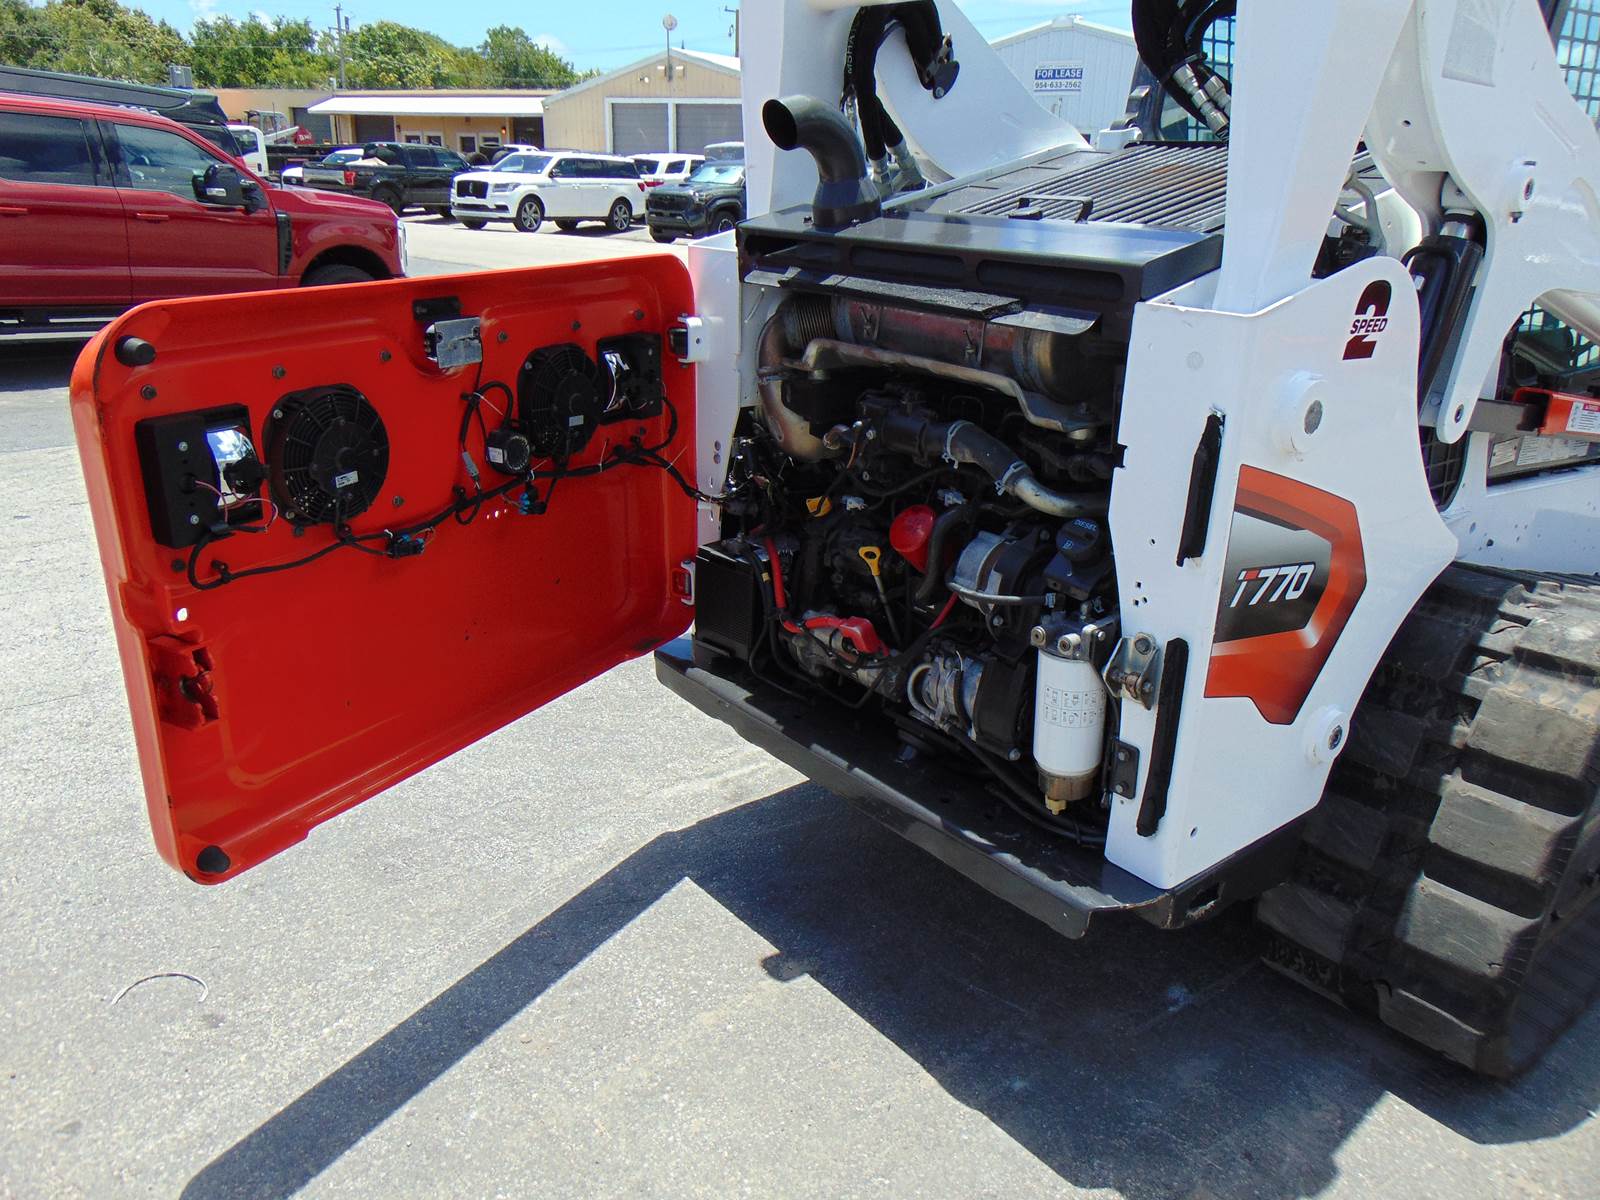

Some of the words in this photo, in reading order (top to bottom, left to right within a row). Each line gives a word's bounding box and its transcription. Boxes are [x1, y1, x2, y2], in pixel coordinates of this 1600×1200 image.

[1036, 69, 1053, 78] FOR
[1055, 69, 1081, 78] LEASE
[1342, 279, 1392, 361] 2
[1350, 317, 1389, 335] SPEED
[1073, 519, 1096, 531] DIESEL
